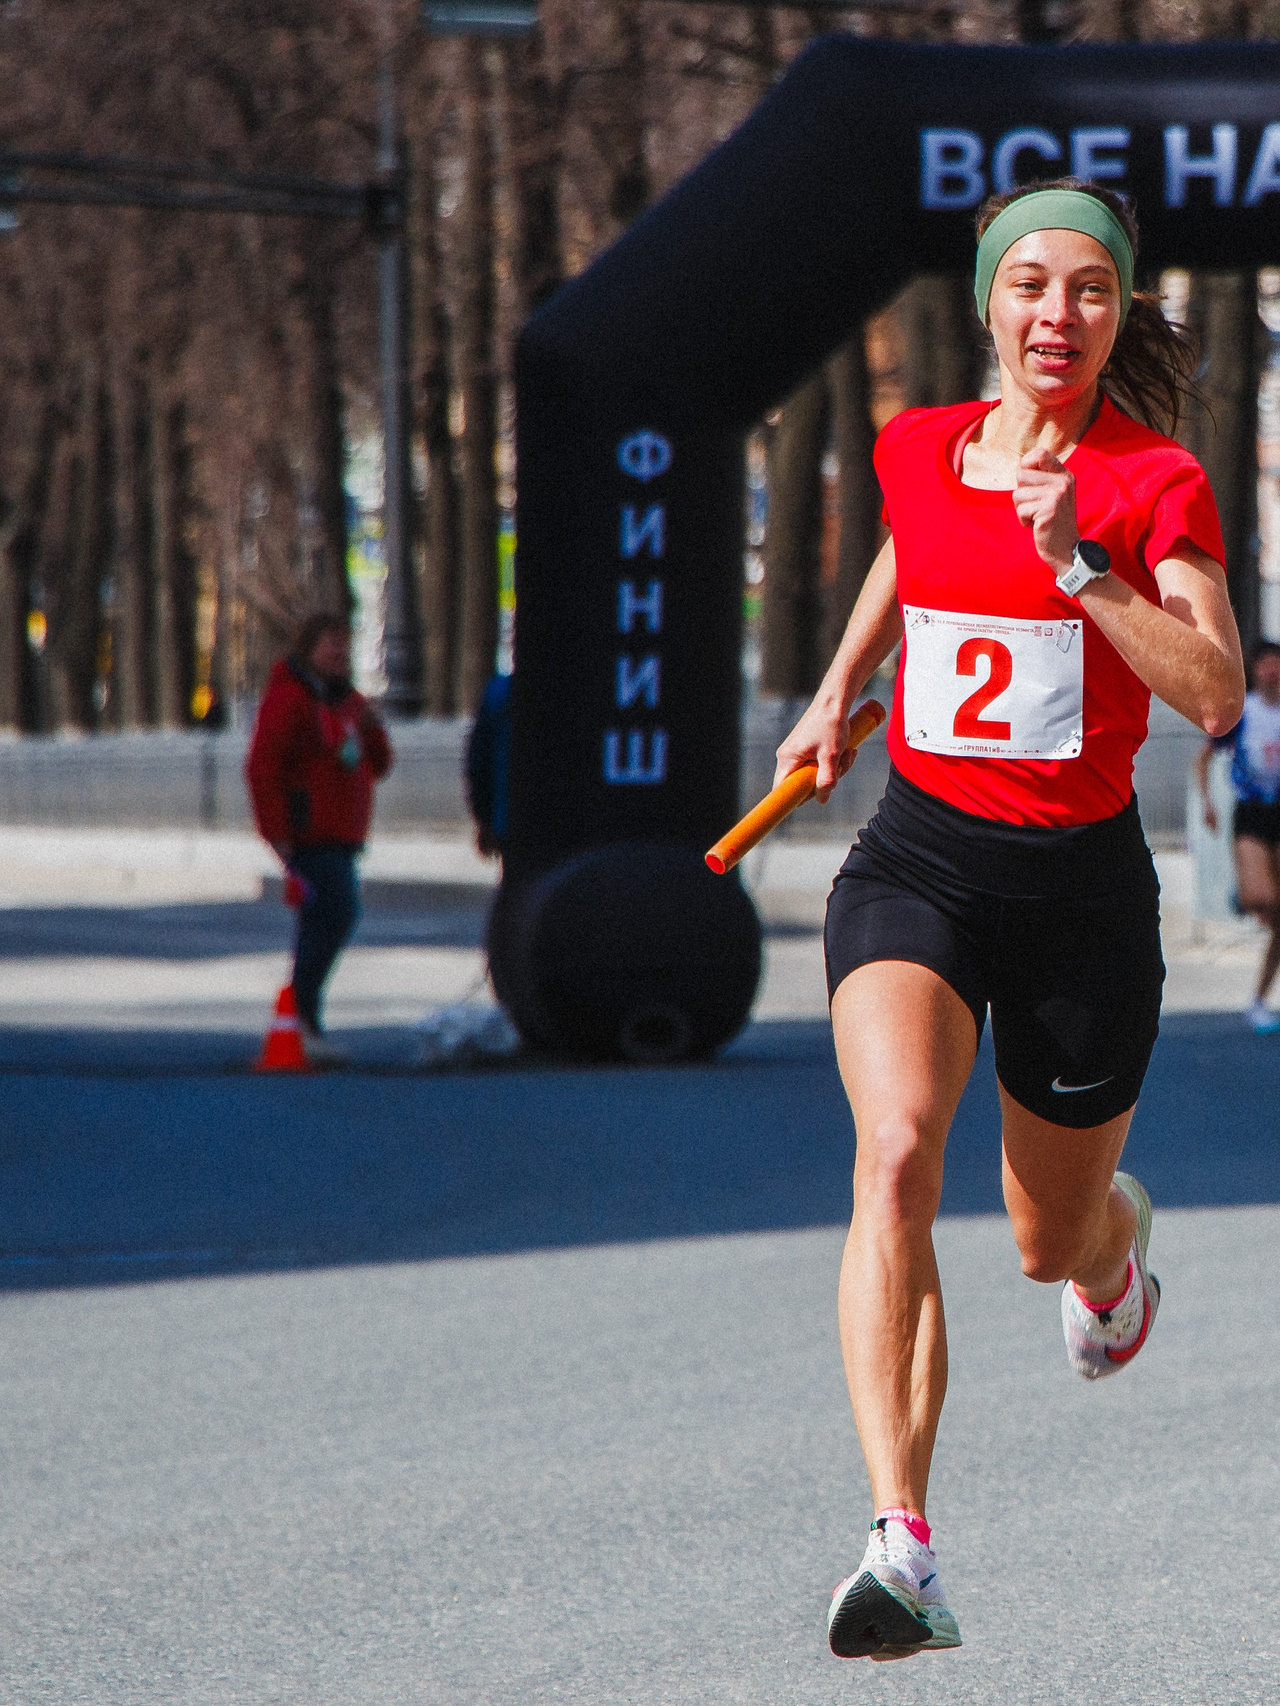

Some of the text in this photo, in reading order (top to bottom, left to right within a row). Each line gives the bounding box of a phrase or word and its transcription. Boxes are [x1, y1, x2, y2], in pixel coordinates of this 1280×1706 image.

[919, 126, 1131, 210] ВСЕ
[602, 428, 673, 785] ФИНИШ
[952, 637, 1013, 740] 2
